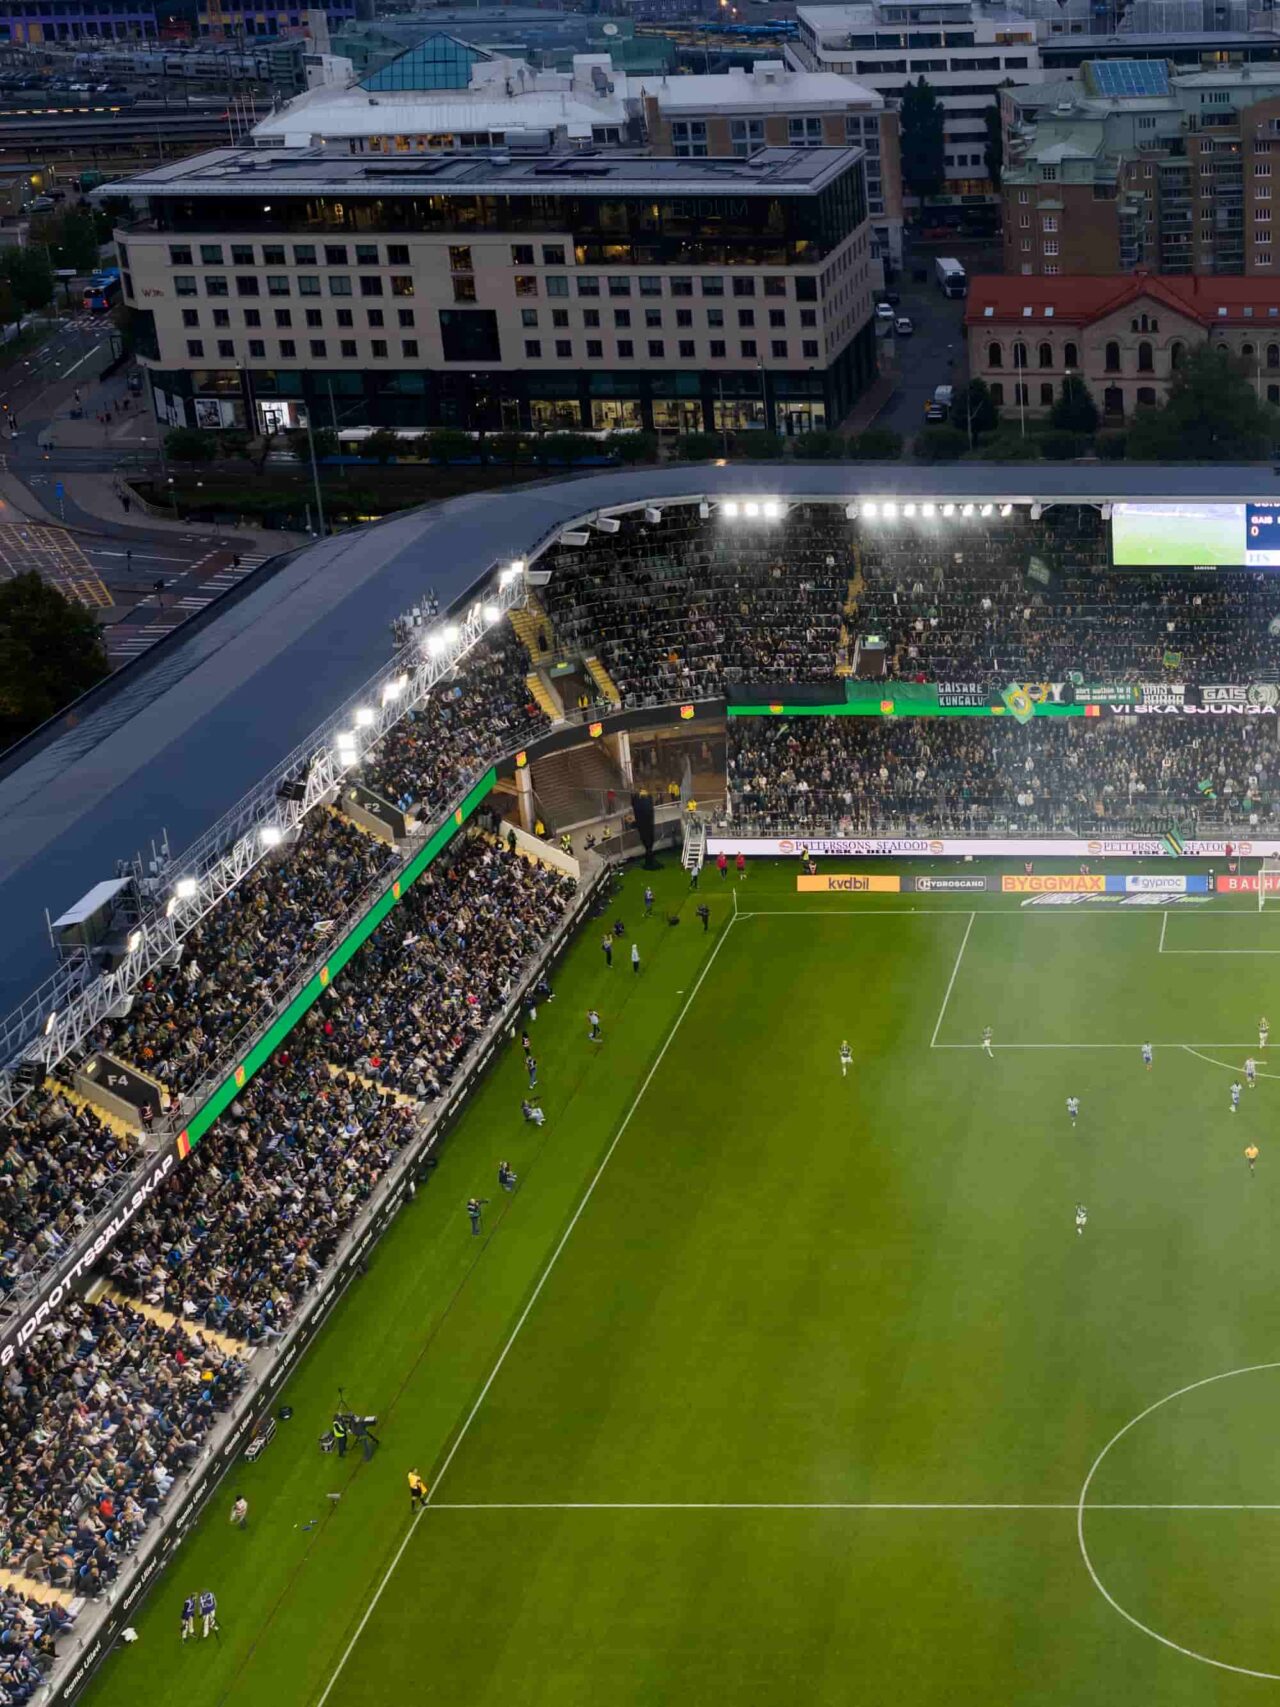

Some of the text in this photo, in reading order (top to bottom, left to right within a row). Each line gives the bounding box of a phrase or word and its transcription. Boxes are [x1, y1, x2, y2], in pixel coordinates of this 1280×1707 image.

[1251, 526, 1259, 536] 0
[938, 682, 983, 694] GAISARE
[1204, 687, 1246, 699] GAIS
[1110, 705, 1129, 713] VI
[1134, 705, 1179, 713] SKA
[364, 803, 381, 812] F2
[876, 841, 928, 850] SEAFOOD
[1104, 842, 1163, 851] PETTERSSO
[828, 877, 869, 890] kvdbil
[918, 879, 984, 889] HYDROSCAND
[1004, 877, 1102, 890] BYGGMAX
[1141, 877, 1181, 888] gyproc
[107, 1075, 128, 1086] F4
[1, 1154, 173, 1367] & IDROTTSSÄLLSKAP
